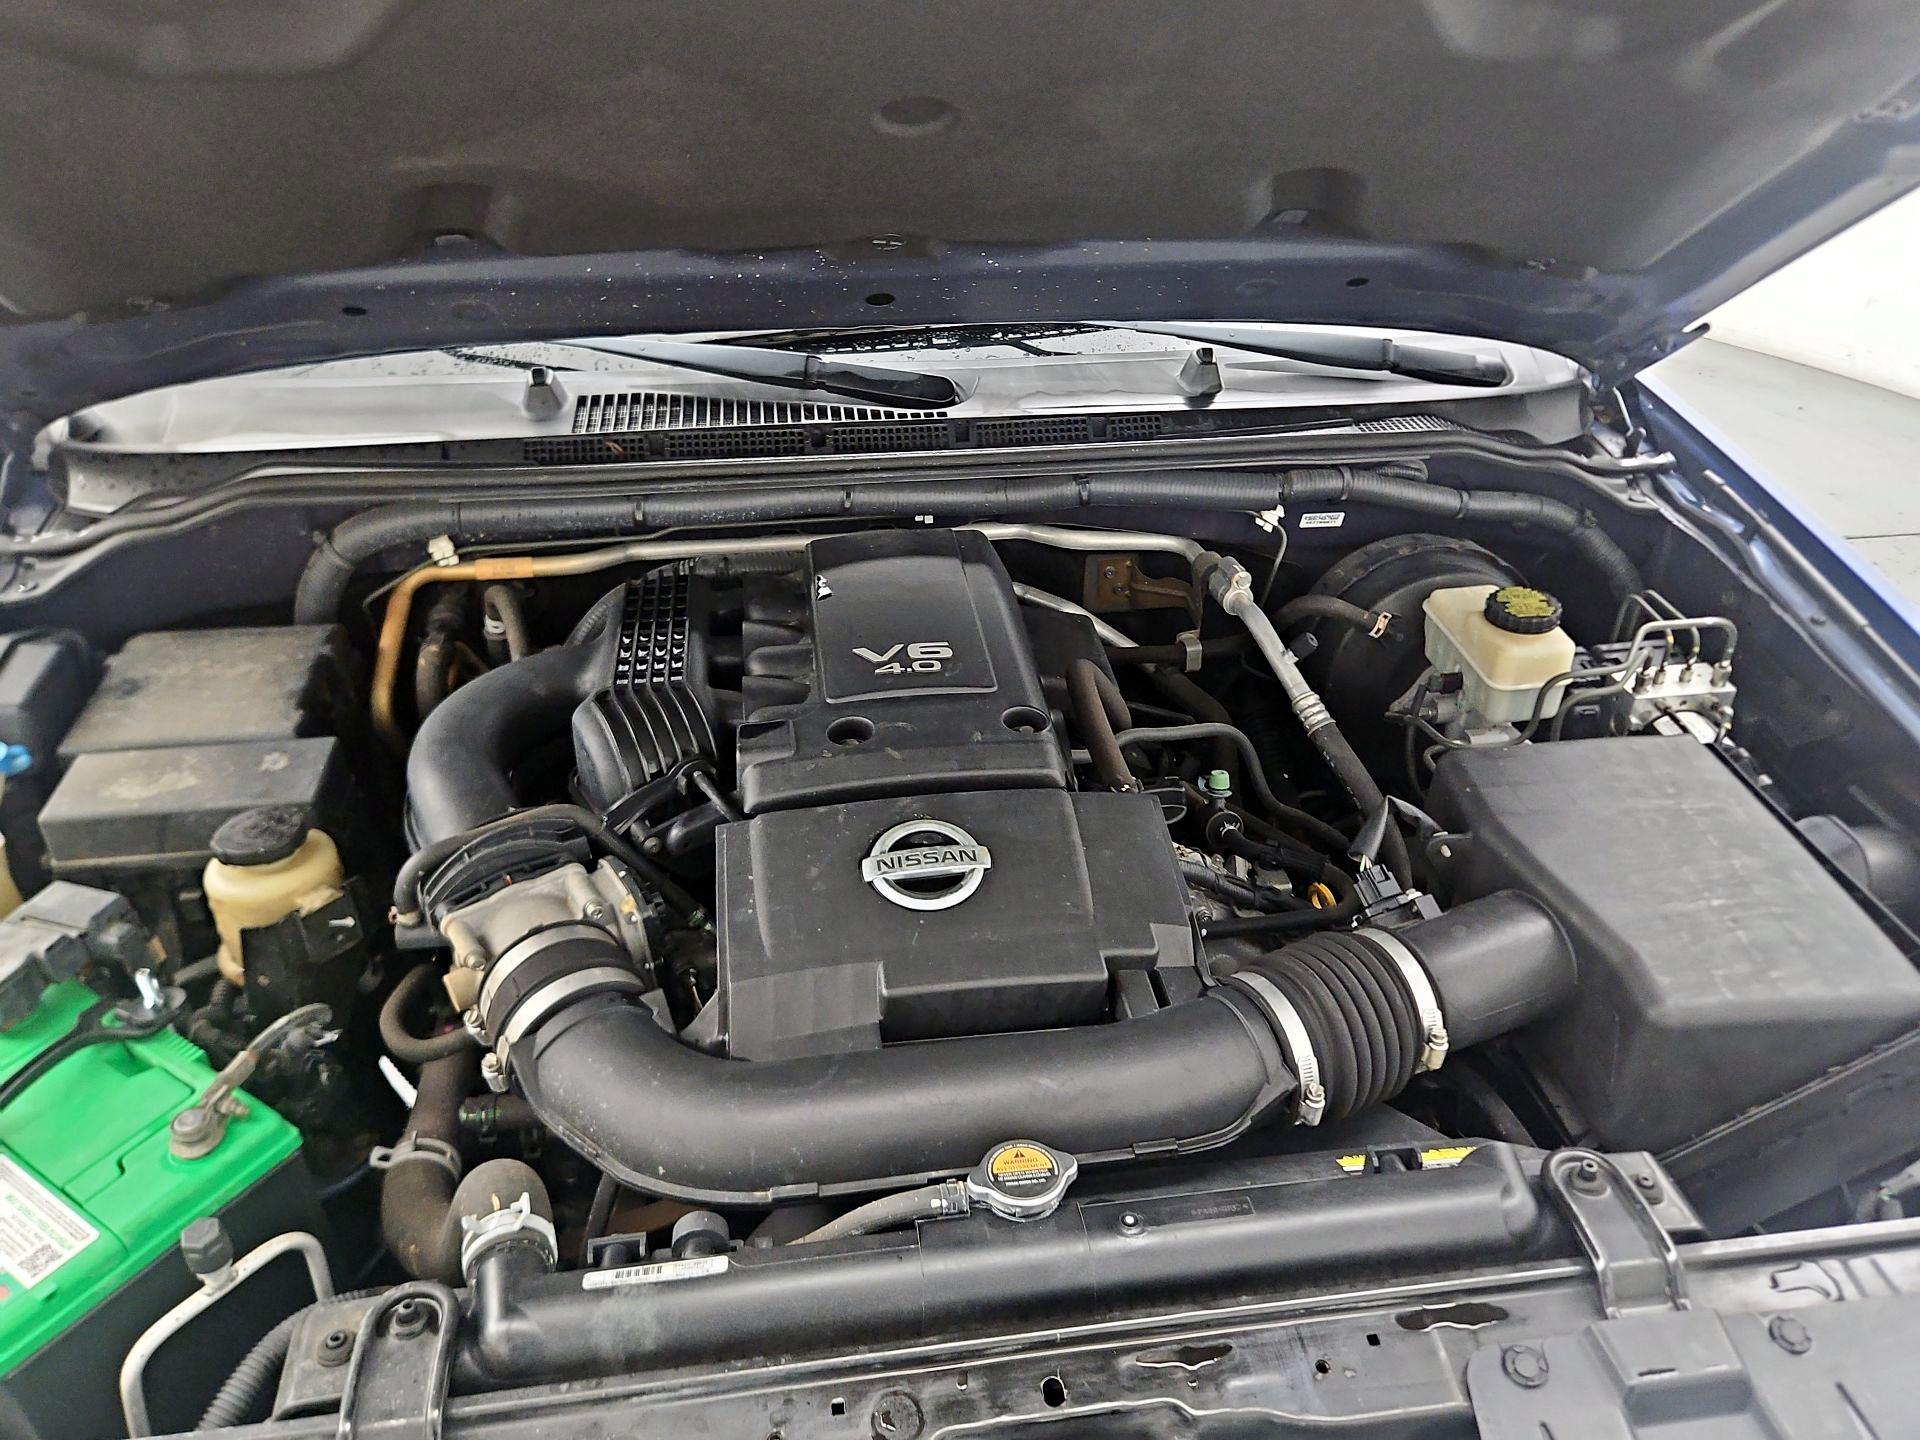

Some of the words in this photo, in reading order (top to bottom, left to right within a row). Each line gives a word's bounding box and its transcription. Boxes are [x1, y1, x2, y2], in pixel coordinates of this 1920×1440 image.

[852, 641, 953, 663] V6
[874, 660, 942, 675] 4.0
[876, 849, 978, 872] NISSAN
[1003, 1157, 1038, 1165] WARNING
